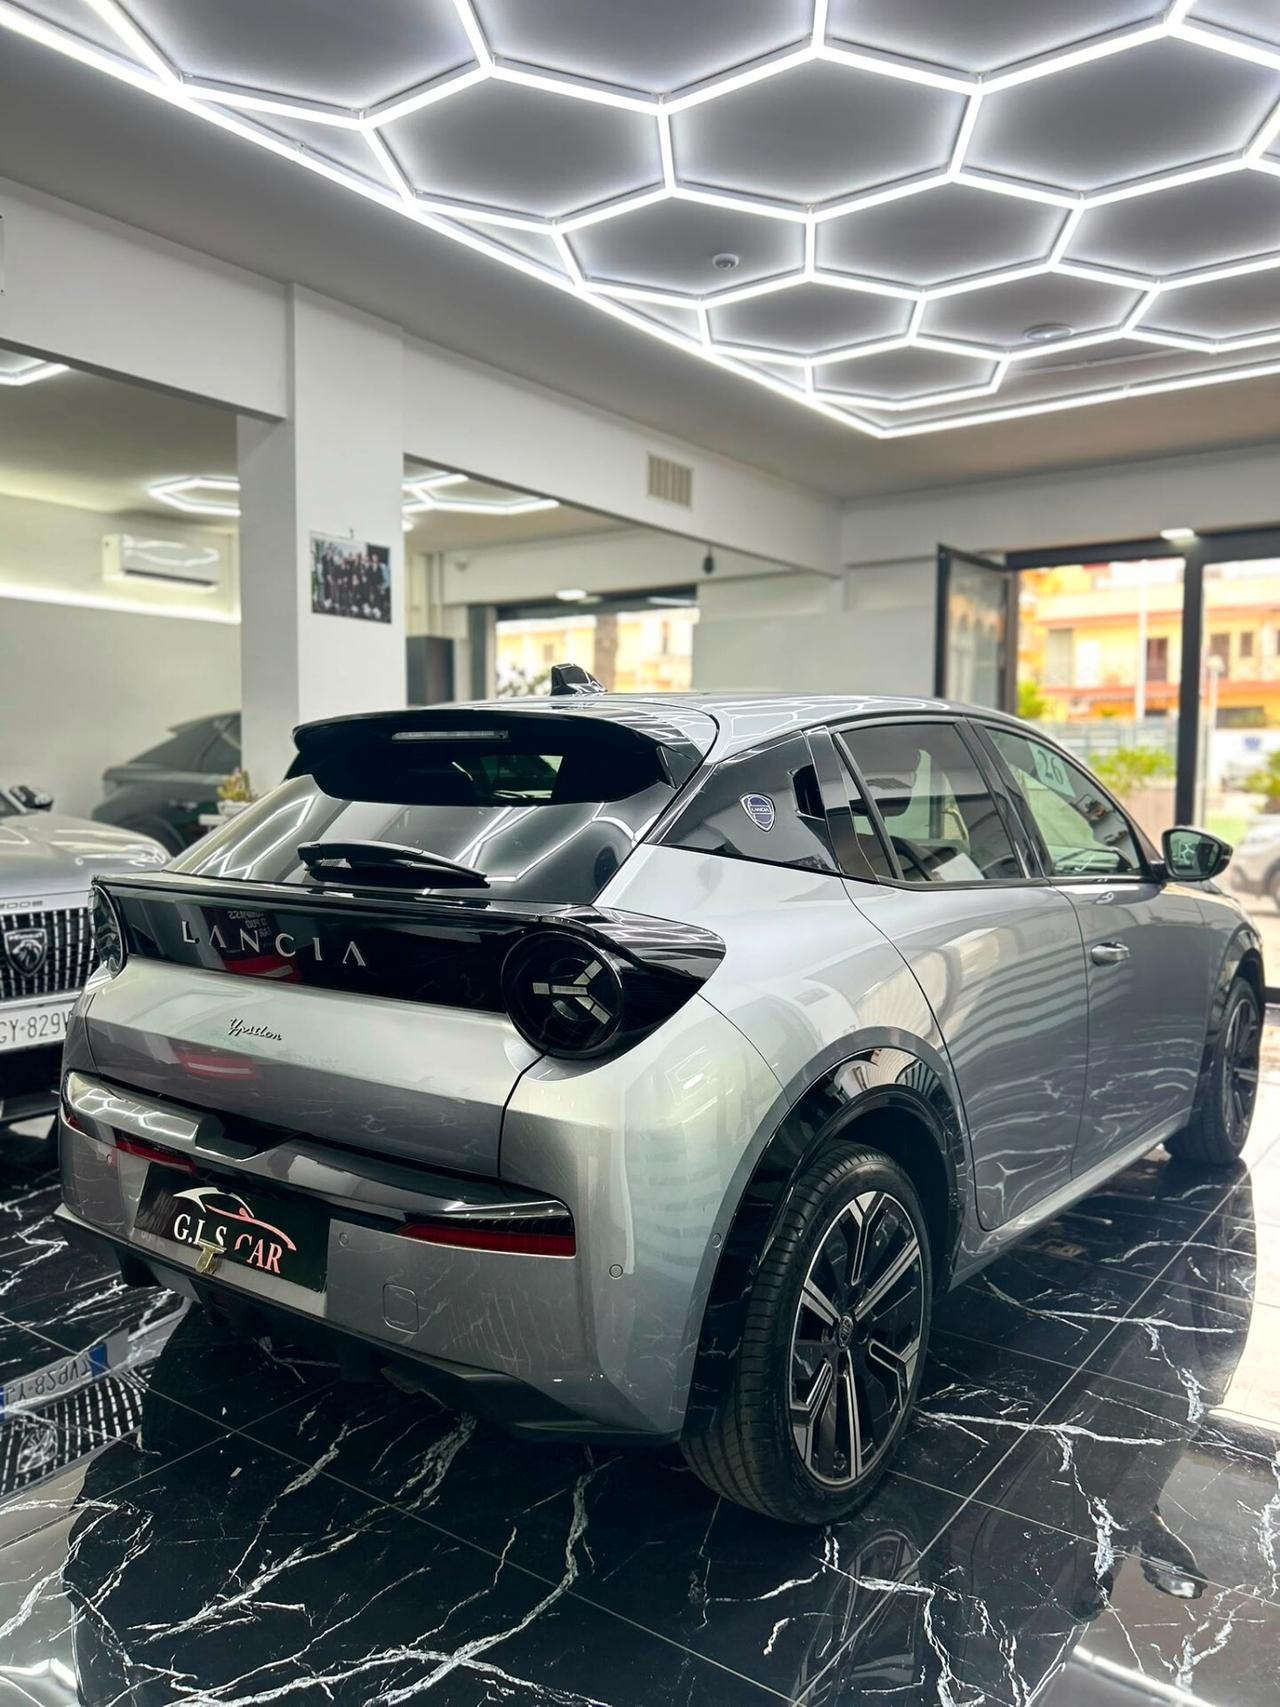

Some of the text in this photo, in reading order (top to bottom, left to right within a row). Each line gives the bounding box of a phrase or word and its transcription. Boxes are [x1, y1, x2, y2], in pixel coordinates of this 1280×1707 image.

[181, 920, 367, 968] LANCIA
[228, 1018, 282, 1041] Ypsilon
[234, 1233, 283, 1274] CAR
